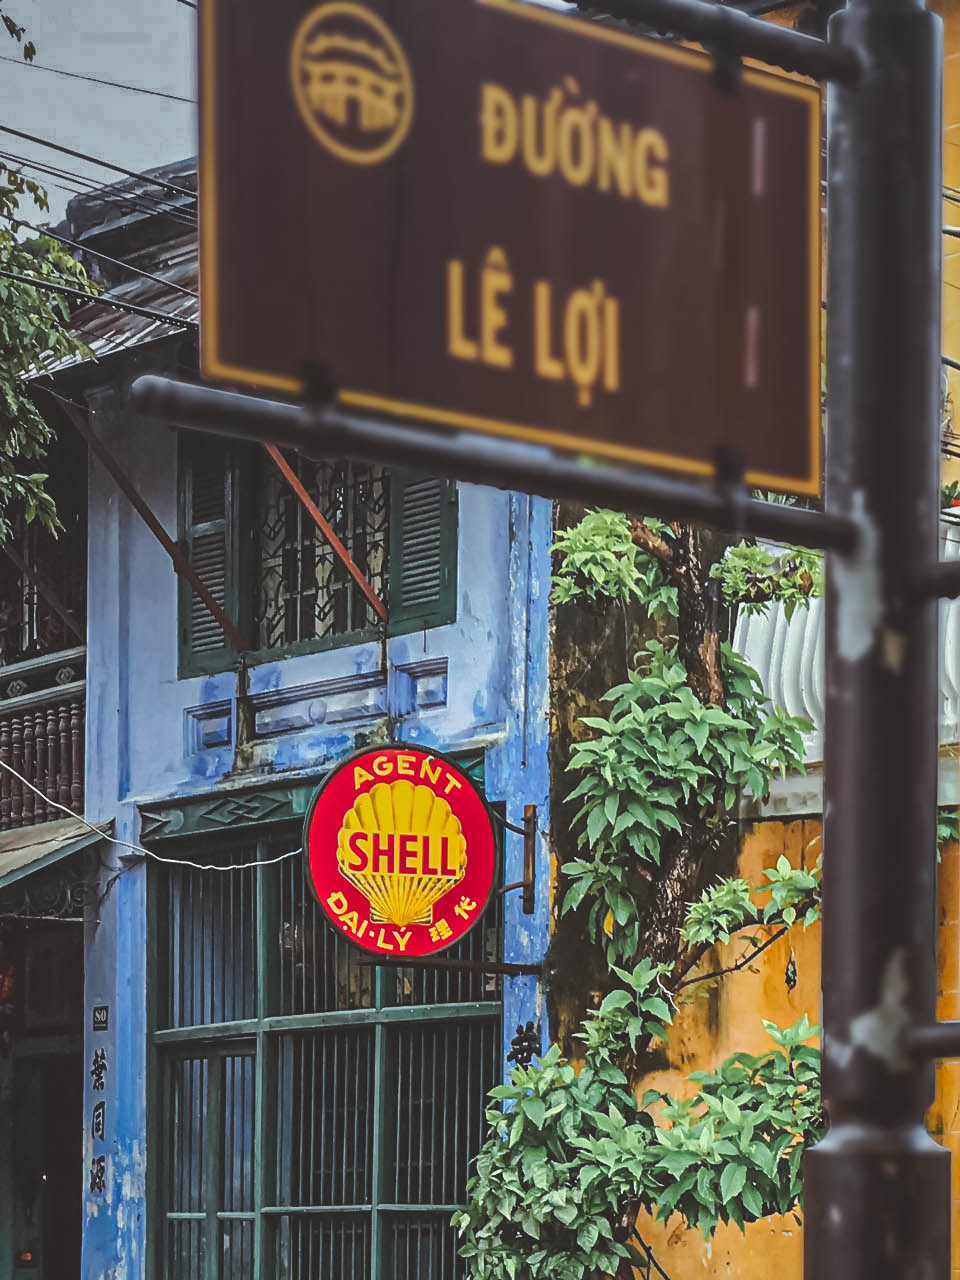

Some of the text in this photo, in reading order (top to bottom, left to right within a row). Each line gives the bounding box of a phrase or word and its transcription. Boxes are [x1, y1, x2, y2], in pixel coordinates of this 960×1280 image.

[481, 76, 669, 208] ĐƯỜNG
[447, 246, 619, 406] LÊ LỢI
[353, 755, 462, 794] AGENT
[348, 831, 457, 876] SHELL
[94, 1010, 107, 1022] 80
